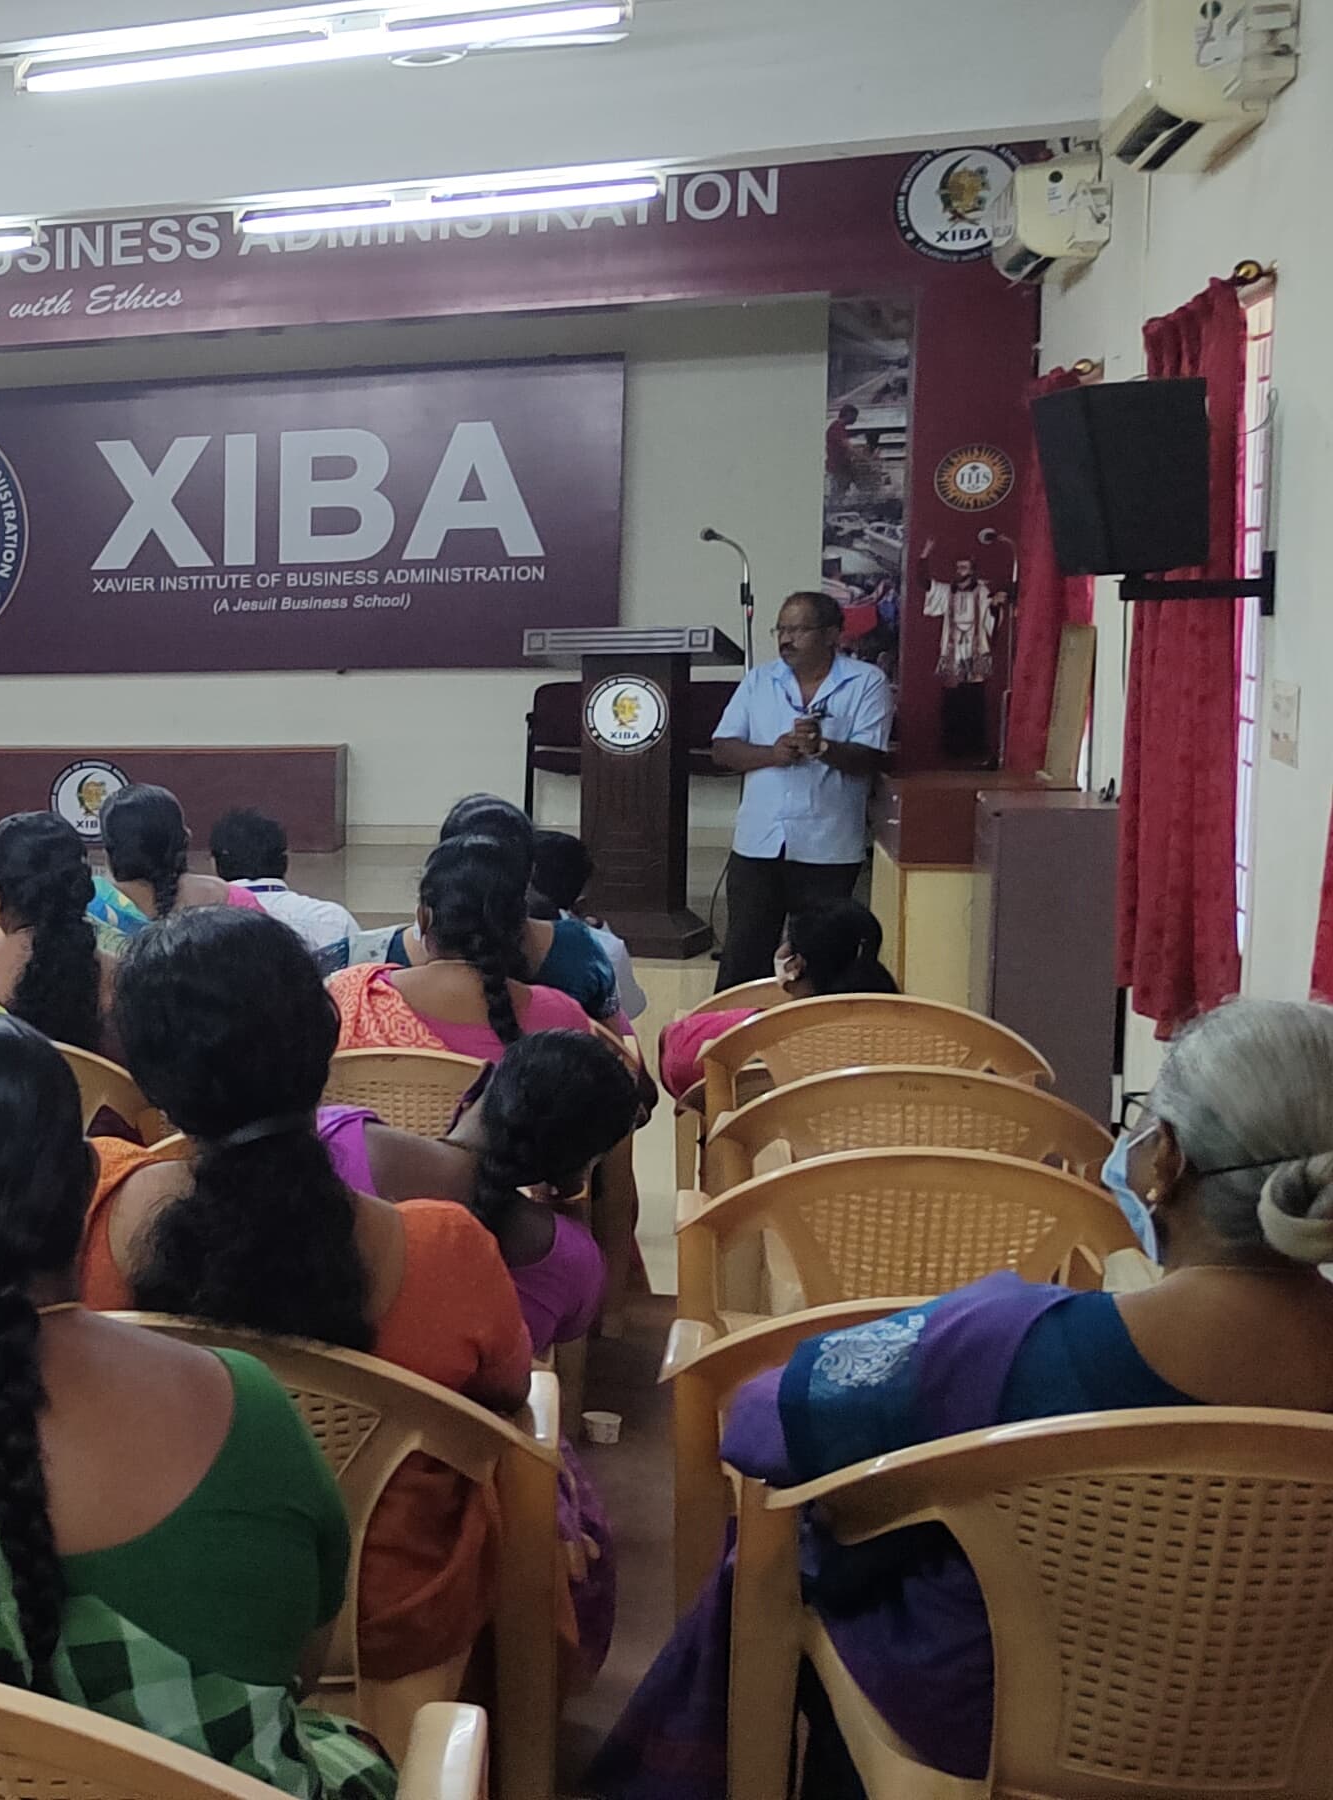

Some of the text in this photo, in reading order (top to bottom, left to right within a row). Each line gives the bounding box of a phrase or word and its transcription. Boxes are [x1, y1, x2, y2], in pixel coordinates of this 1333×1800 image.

[936, 227, 988, 243] XIBA
[9, 288, 74, 319] with
[85, 283, 183, 316] Ethics
[90, 418, 545, 571] XIBA
[92, 565, 546, 593] XAVIER INSTITUTE OF BUSINESS ADMINISTRATION
[213, 592, 412, 615] (A Jesuit Business School)
[76, 820, 99, 829] XIB
